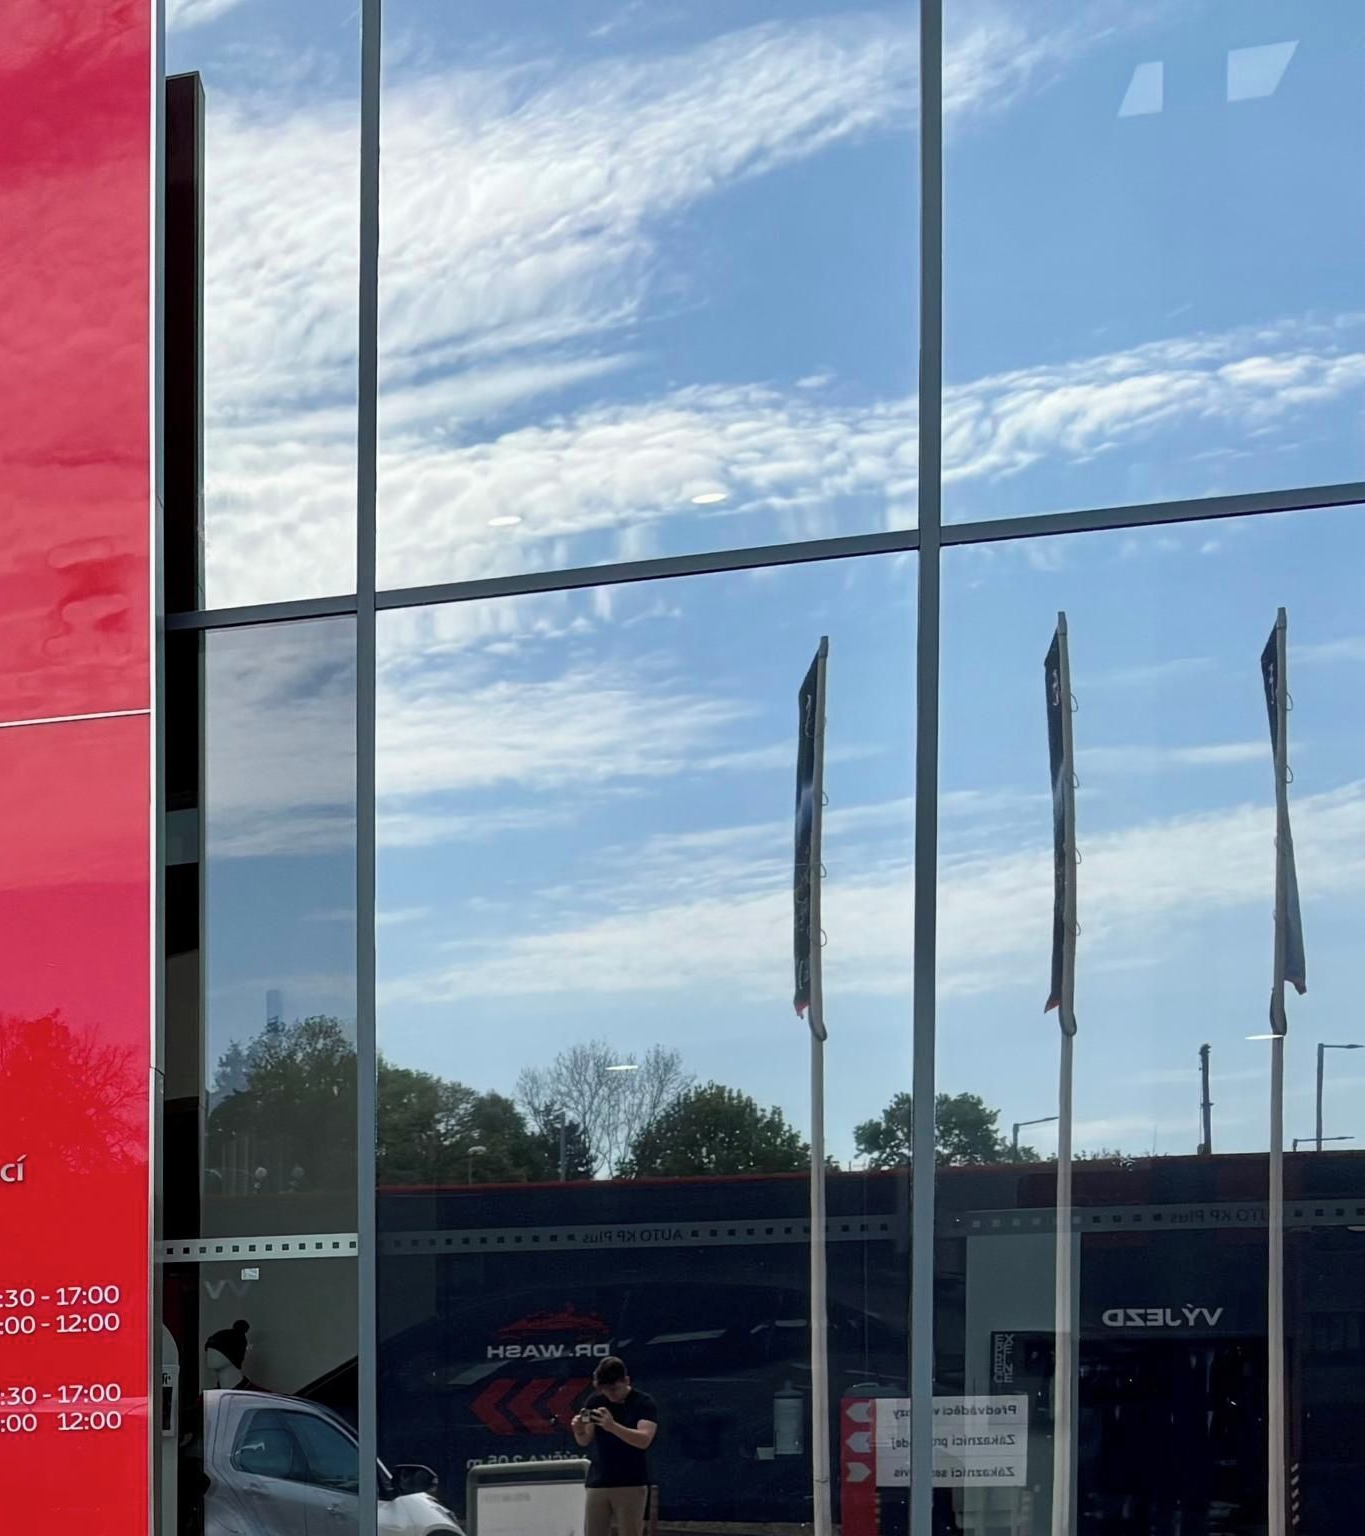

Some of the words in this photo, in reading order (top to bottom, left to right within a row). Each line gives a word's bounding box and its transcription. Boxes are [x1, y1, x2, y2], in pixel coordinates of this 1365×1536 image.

[56, 1285, 120, 1306] 17:00
[56, 1312, 120, 1333] 12:00
[57, 1383, 121, 1404] 17:00
[57, 1411, 122, 1431] 12:00
